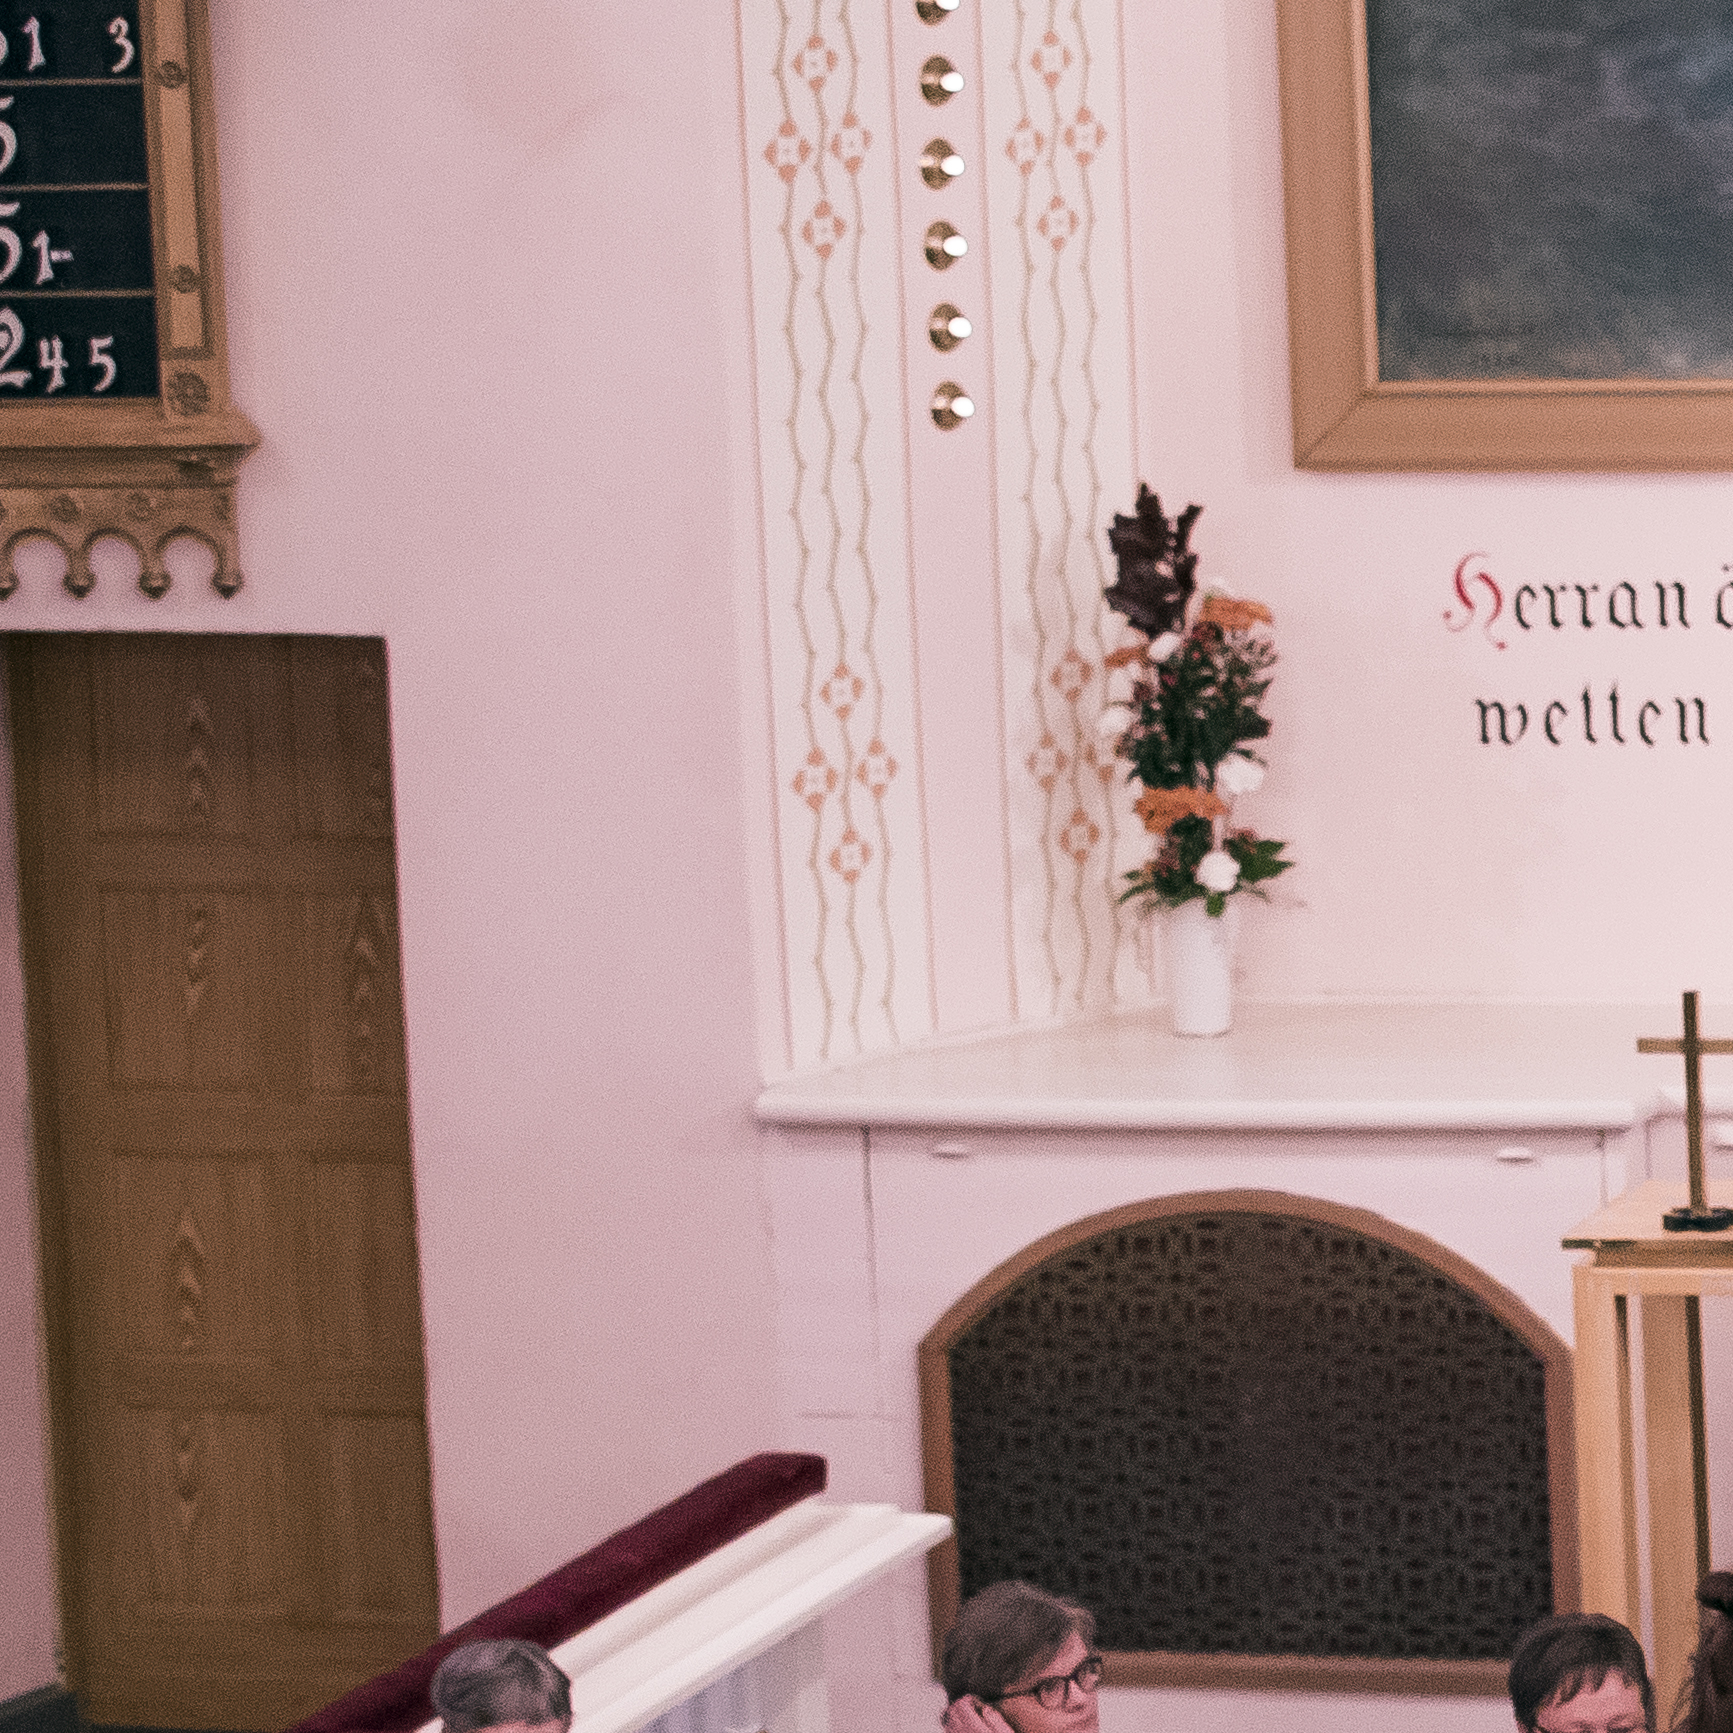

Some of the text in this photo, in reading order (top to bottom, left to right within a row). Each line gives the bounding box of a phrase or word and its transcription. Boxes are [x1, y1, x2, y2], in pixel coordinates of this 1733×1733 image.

[108, 16, 135, 73] 3
[1443, 552, 1690, 650] Herran
[1474, 680, 1711, 747] wetten
